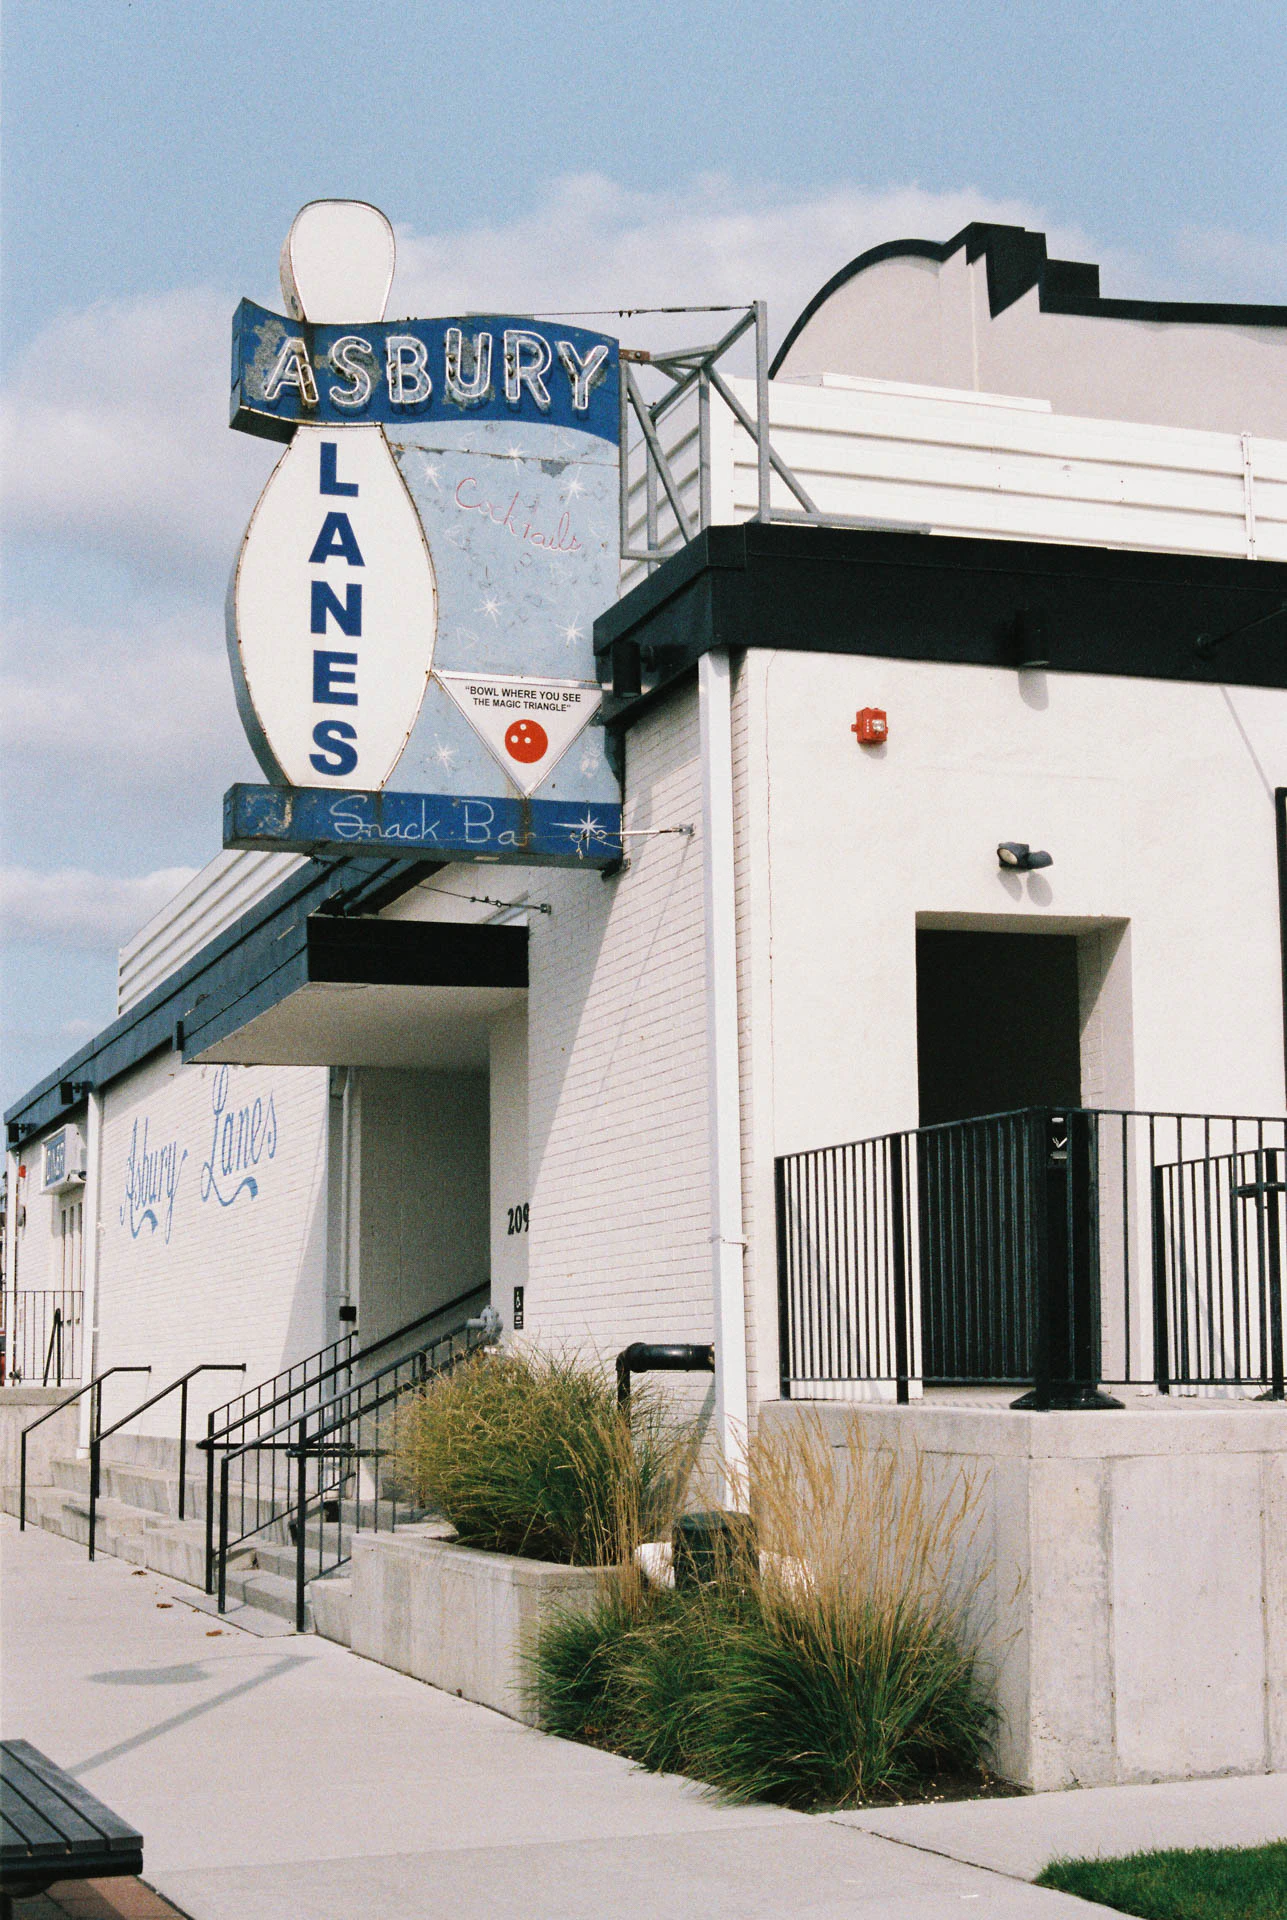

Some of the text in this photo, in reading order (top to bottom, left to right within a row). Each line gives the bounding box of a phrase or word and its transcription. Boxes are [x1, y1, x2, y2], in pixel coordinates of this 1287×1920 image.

[265, 327, 609, 411] ASBURY
[308, 441, 365, 777] LANES
[473, 697, 490, 706] THE
[493, 699, 521, 709] MAGIC
[502, 687, 537, 699] WHERE
[540, 691, 560, 701] YOU
[562, 693, 581, 703] SEE
[329, 795, 537, 847] Snack Bar
[200, 1064, 277, 1207] Lanes
[507, 1202, 530, 1236] 209
